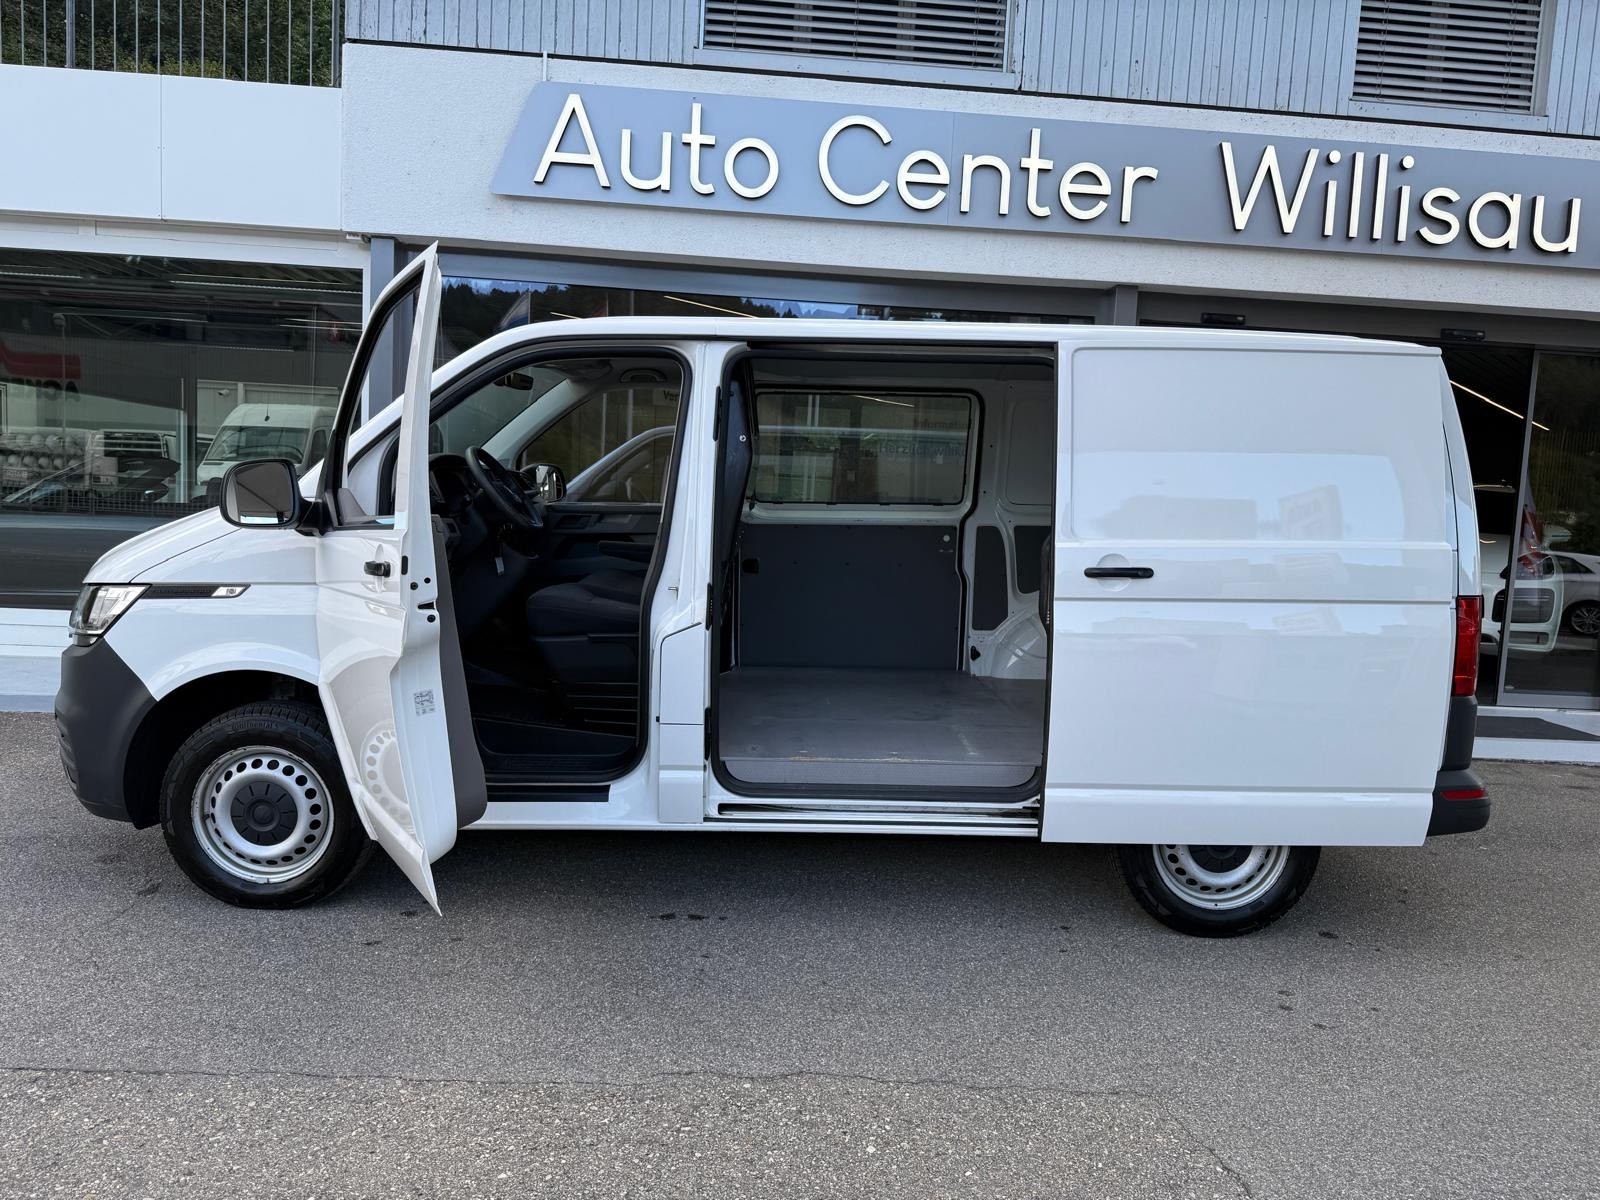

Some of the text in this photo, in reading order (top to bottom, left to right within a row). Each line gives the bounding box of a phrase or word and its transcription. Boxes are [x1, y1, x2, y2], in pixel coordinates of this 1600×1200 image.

[533, 93, 1583, 254] Auto Center Willisau
[662, 390, 679, 402] Ver
